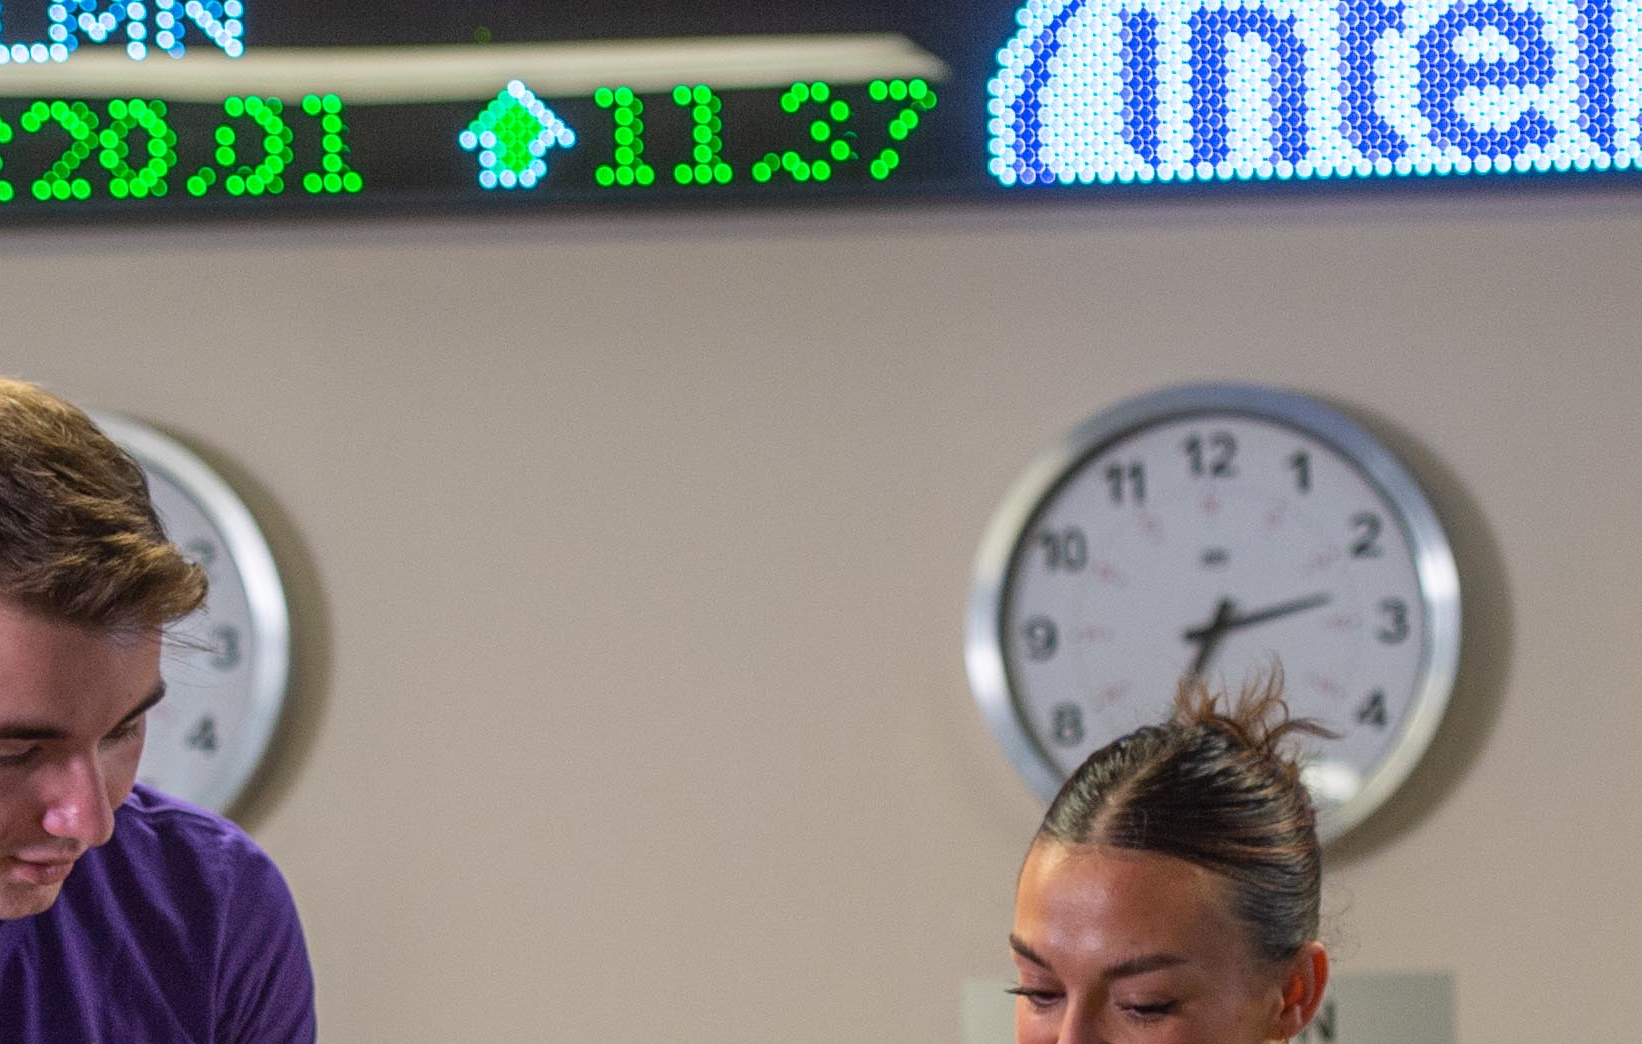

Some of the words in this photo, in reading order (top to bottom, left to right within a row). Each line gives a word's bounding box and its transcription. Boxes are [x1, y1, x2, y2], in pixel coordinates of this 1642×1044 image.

[594, 78, 939, 188] 11.37
[1183, 430, 1239, 479] 12
[1287, 448, 1313, 493] 1
[1104, 460, 1146, 506] 11
[1039, 525, 1088, 573] 10
[1349, 510, 1383, 560] 2
[1023, 614, 1059, 662] 9
[1377, 598, 1409, 645] 3
[1051, 702, 1085, 748] 8
[1354, 688, 1387, 729] 4
